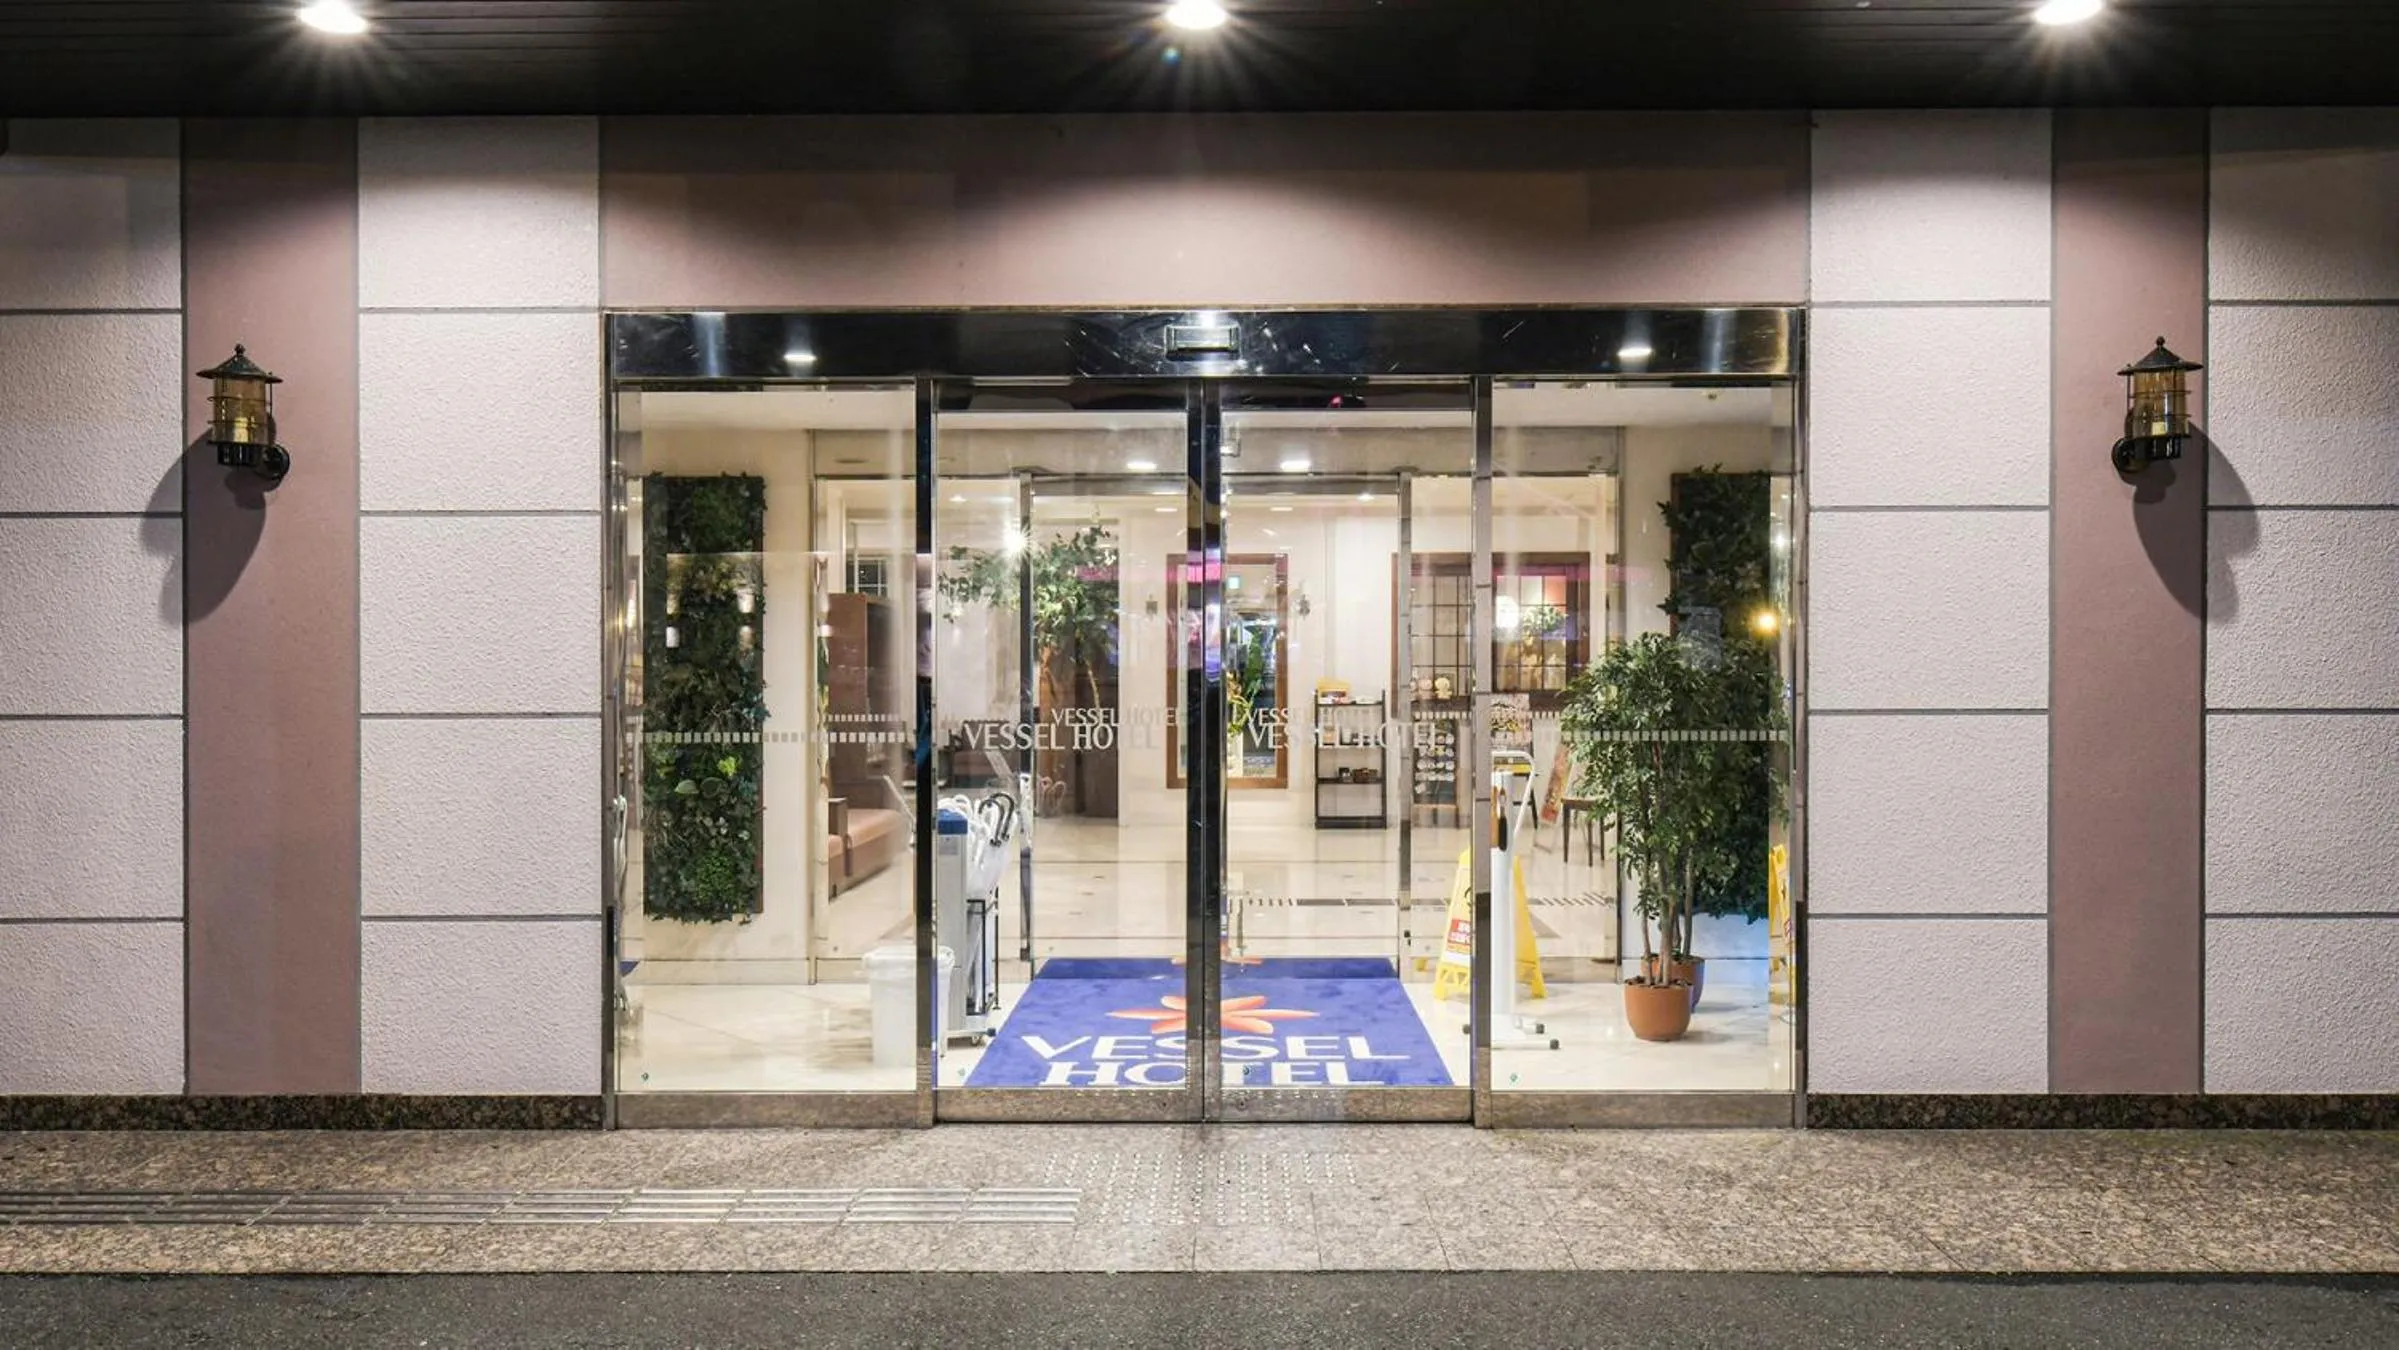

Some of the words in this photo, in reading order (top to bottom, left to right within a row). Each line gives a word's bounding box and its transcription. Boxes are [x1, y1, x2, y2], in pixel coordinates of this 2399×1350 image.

[1051, 707, 1120, 727] VESSEL
[964, 723, 1065, 750] VESSEL
[1248, 722, 1349, 749] VESEL
[1022, 1035, 1411, 1060] VESSEL
[1039, 1061, 1385, 1087] HOTEL
